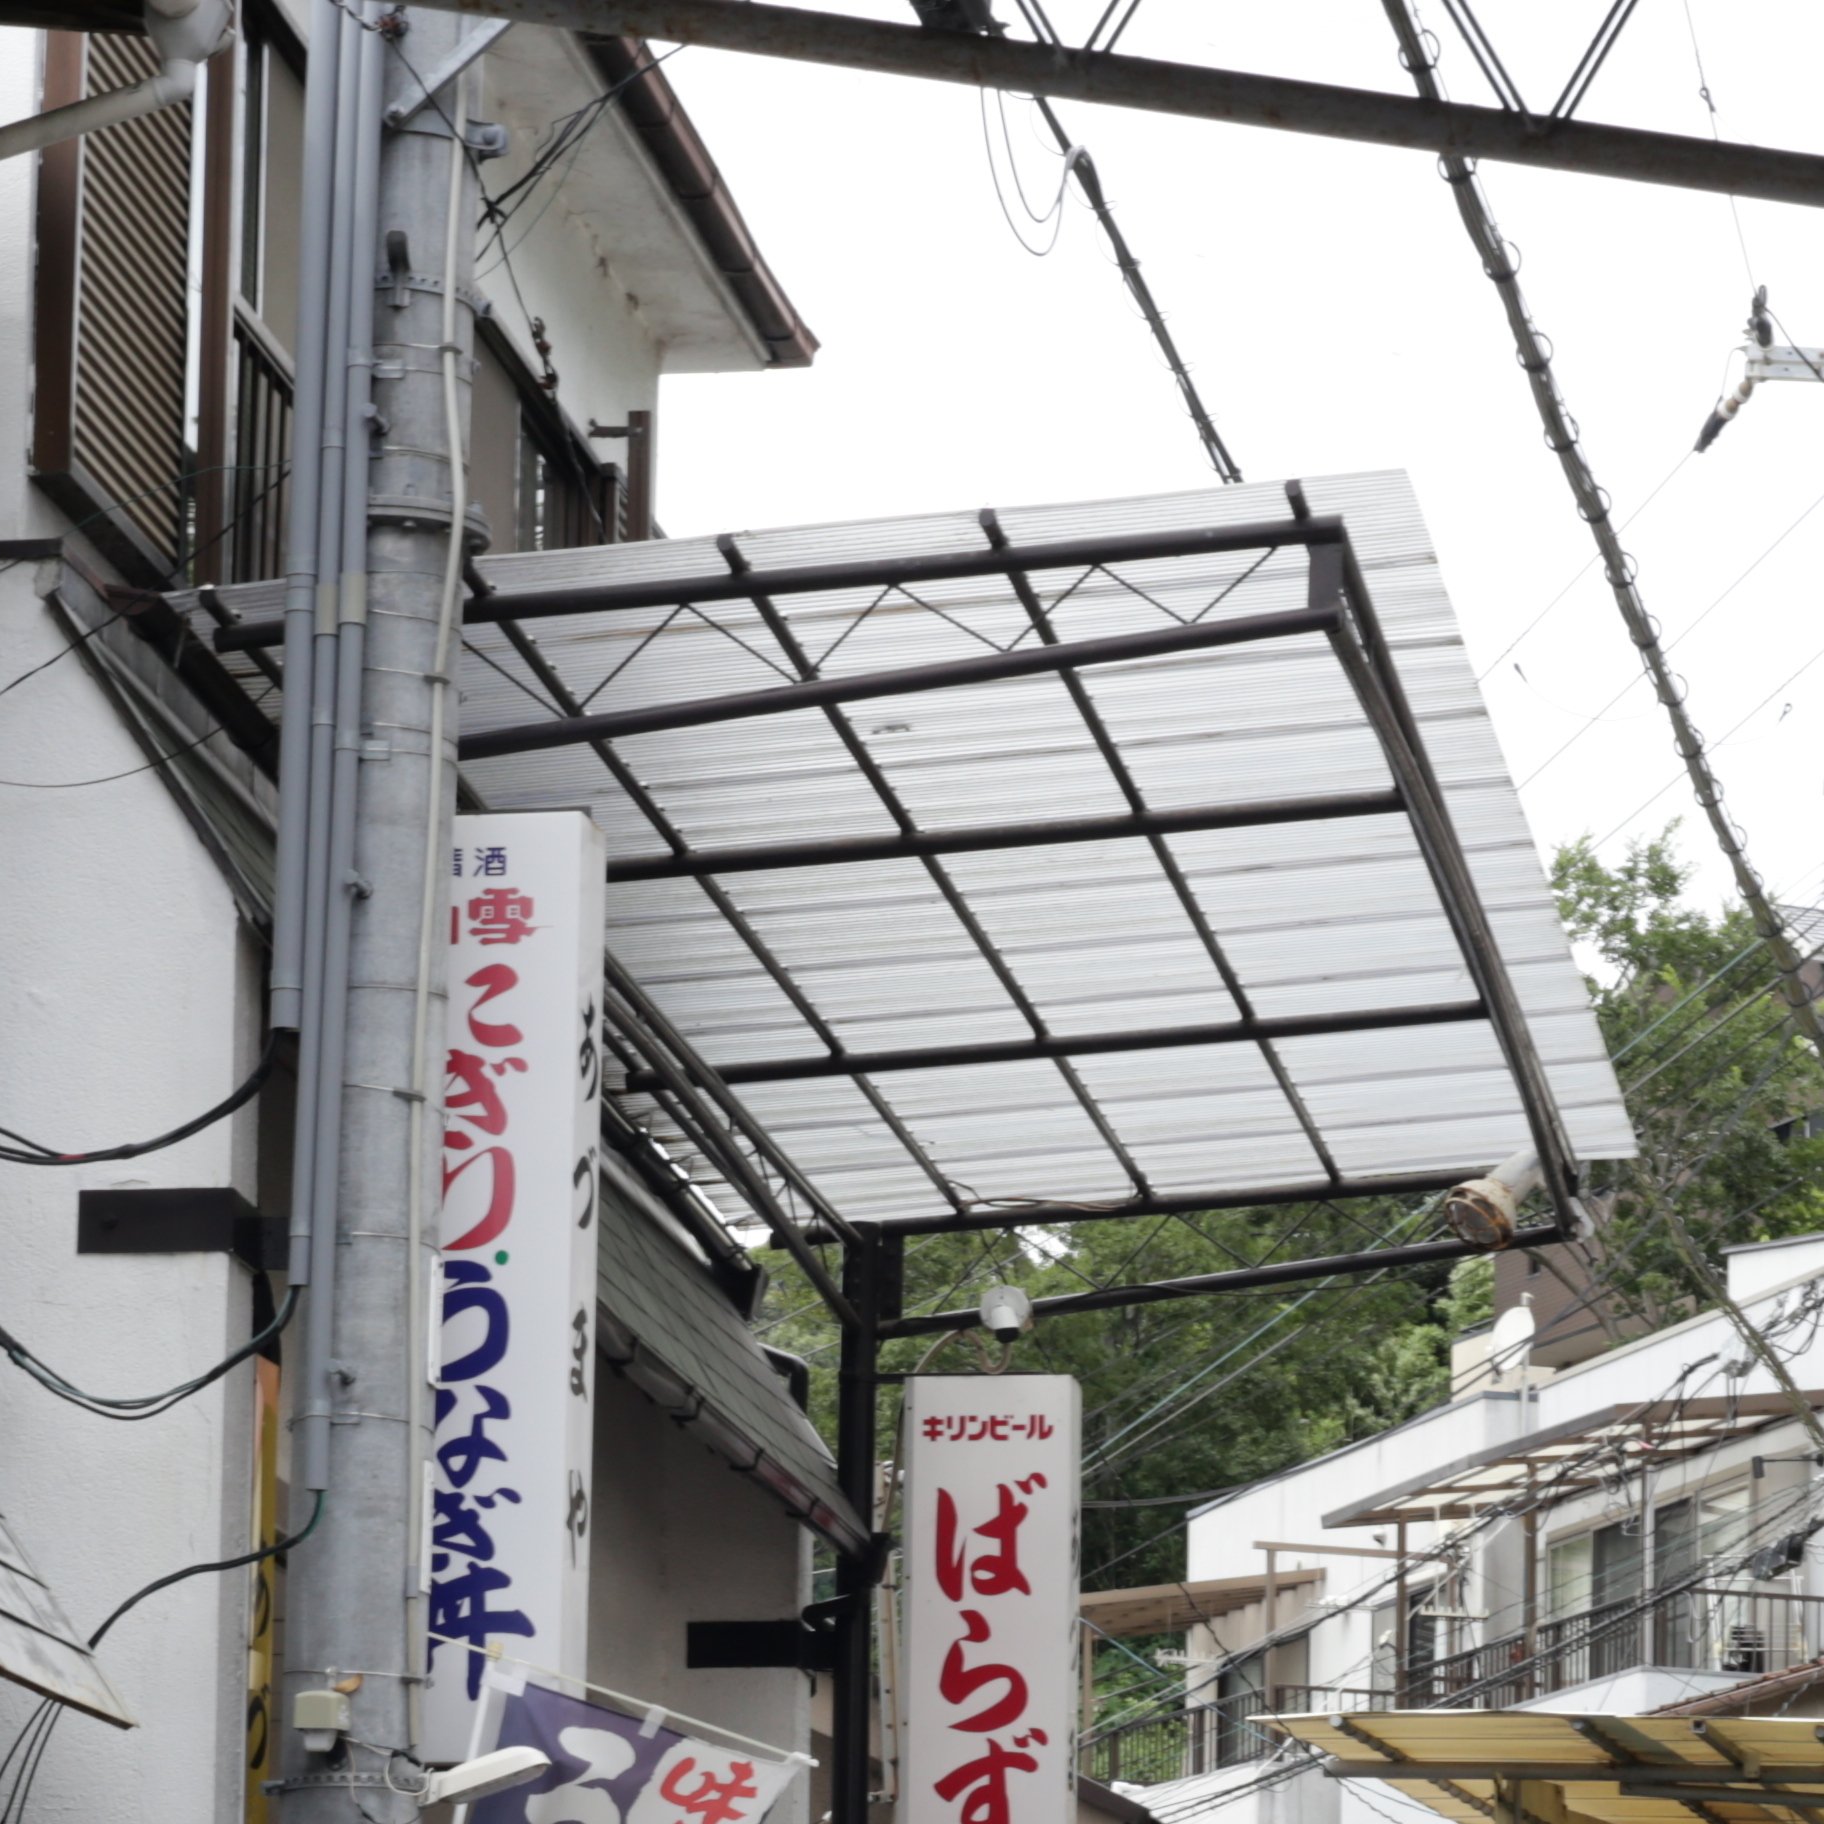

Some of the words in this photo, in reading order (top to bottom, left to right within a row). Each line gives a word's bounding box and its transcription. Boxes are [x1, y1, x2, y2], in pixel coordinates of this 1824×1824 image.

[451, 888, 538, 945] 雪
[922, 1413, 1054, 1442] キリンビール
